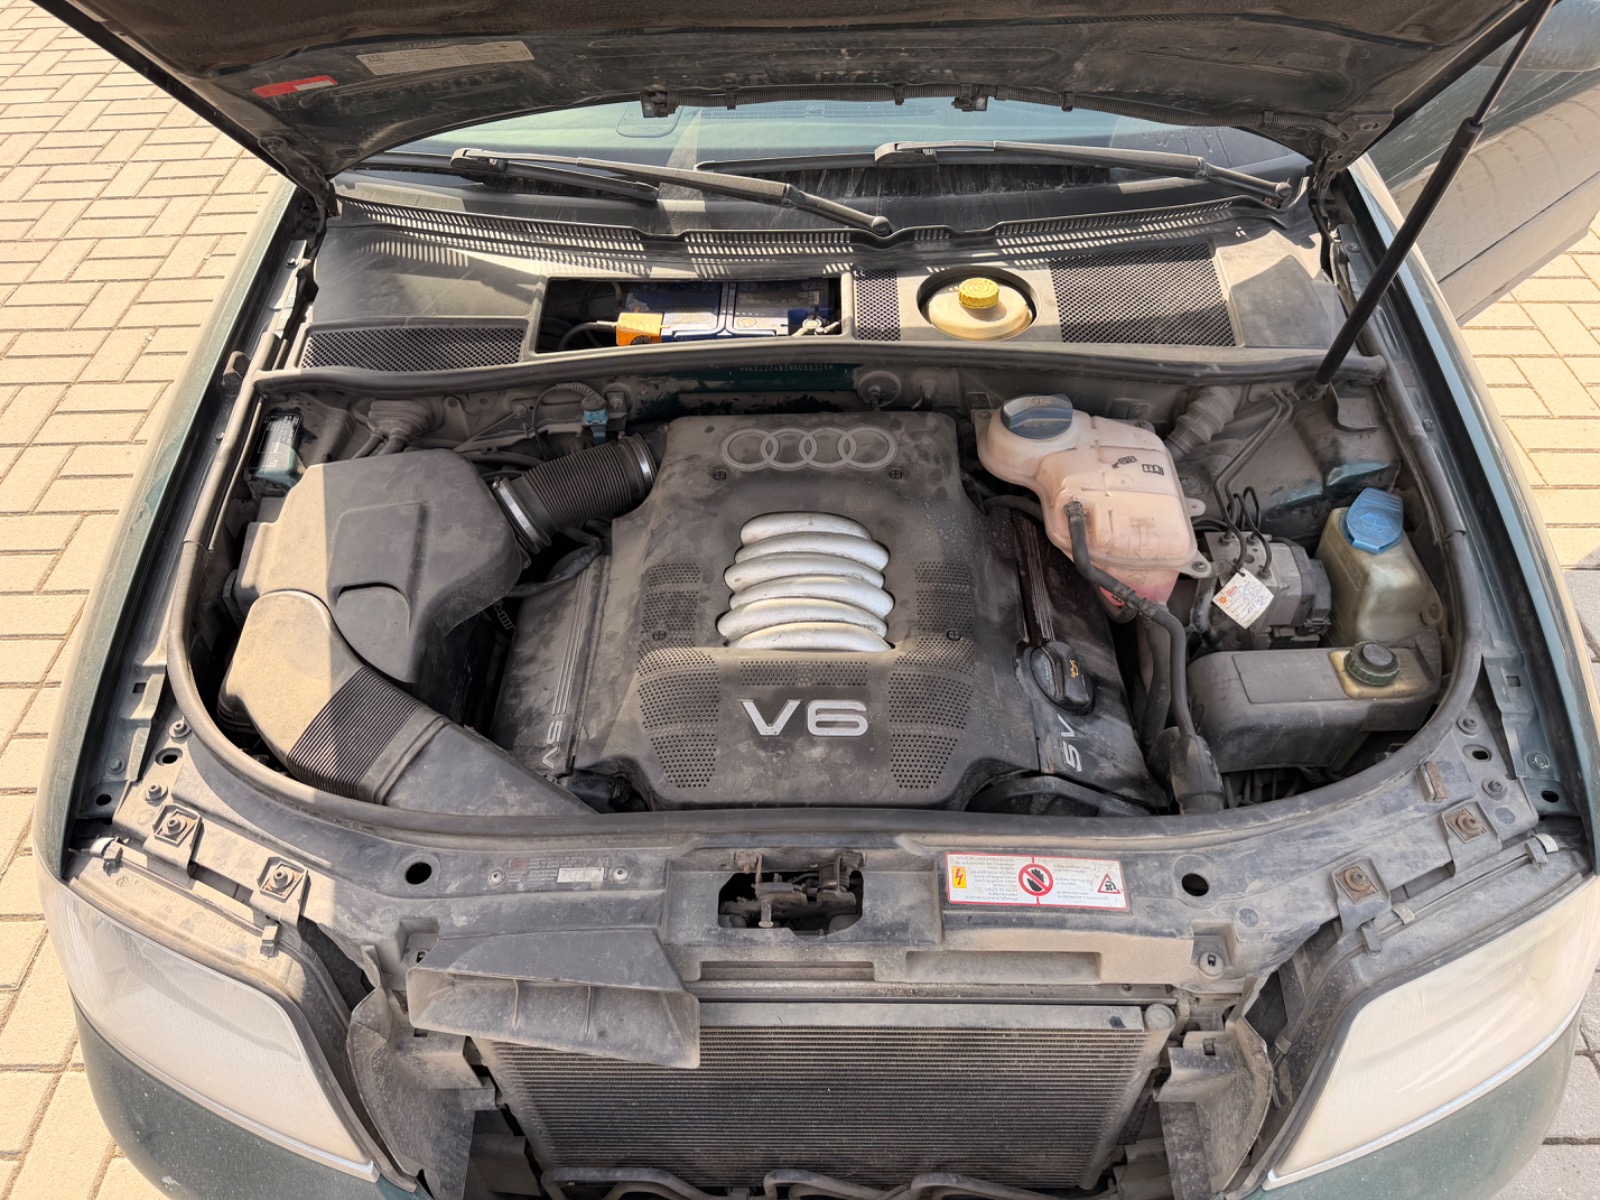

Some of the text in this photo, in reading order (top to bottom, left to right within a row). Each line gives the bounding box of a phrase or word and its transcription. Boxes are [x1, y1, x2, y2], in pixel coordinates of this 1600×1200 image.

[740, 699, 869, 737] V6
[541, 720, 564, 769] 5V
[1057, 713, 1083, 773] 5V
